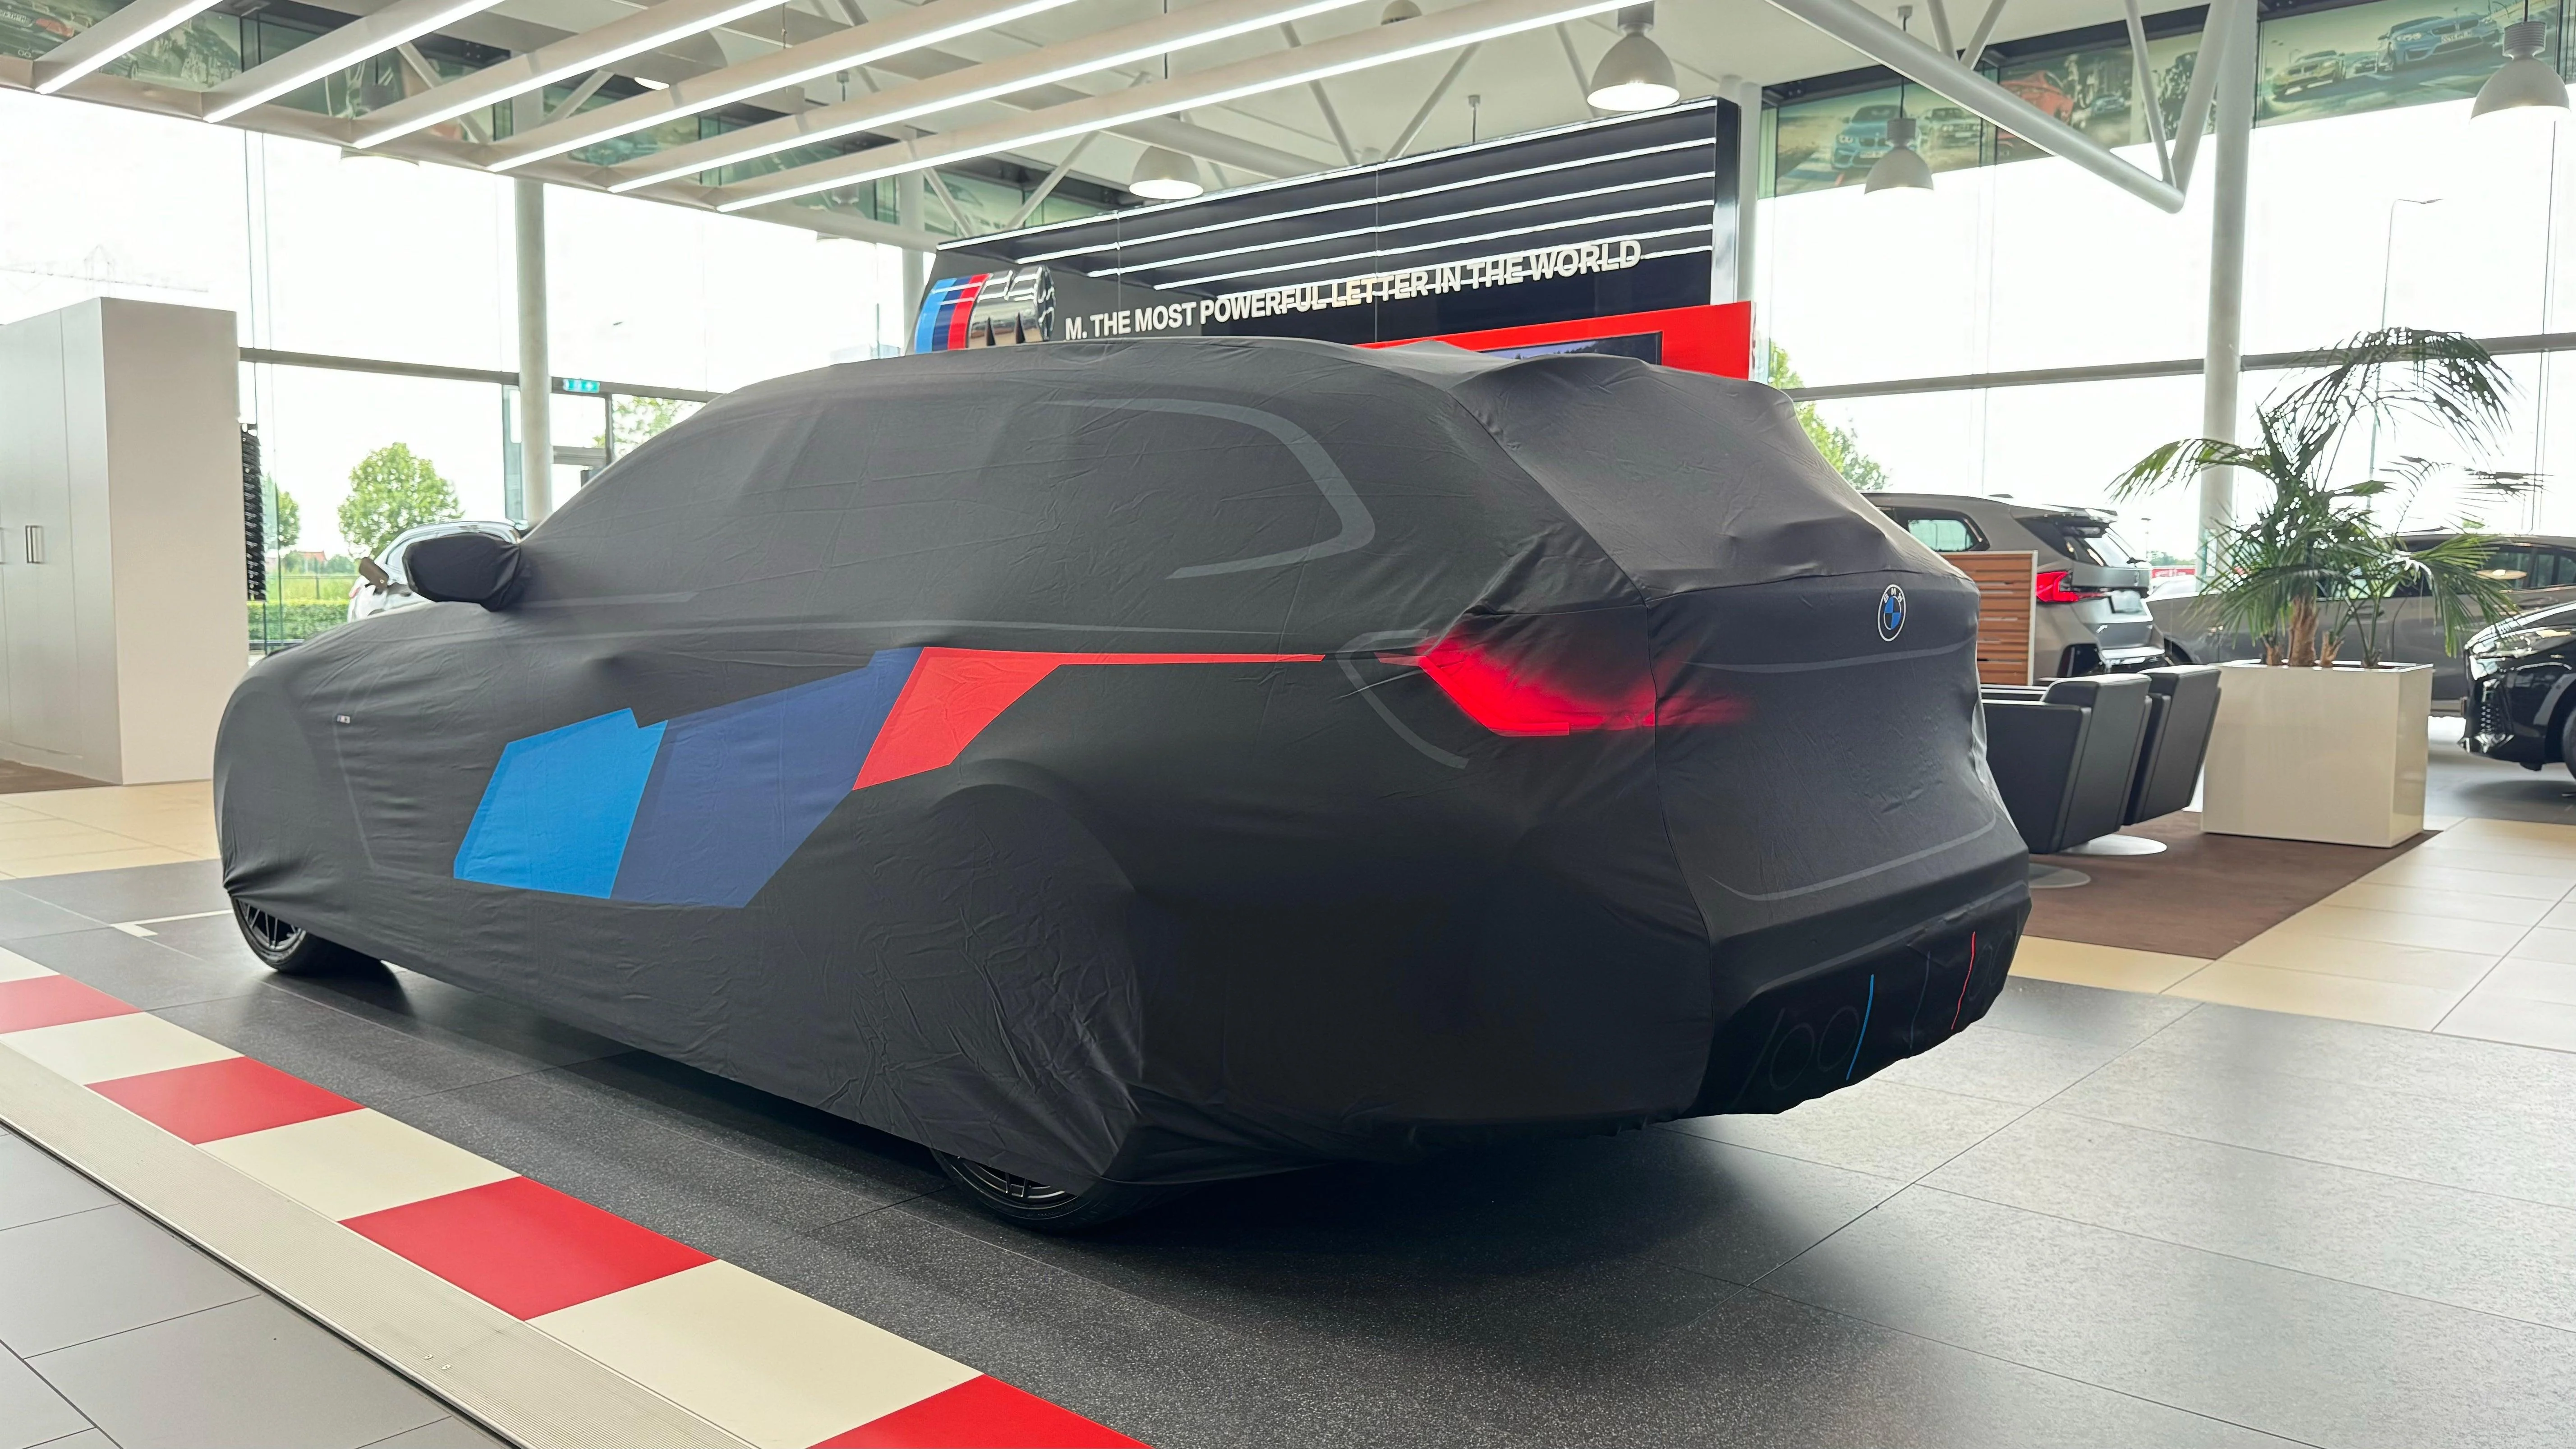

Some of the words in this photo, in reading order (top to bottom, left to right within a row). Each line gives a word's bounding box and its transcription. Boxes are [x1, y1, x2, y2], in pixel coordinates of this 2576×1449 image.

[1065, 317, 1086, 340] M.
[1090, 310, 1131, 337] THE
[1135, 302, 1196, 332] MOST
[1200, 286, 1327, 324] POWERFUL
[1331, 271, 1428, 308] LETTER
[1435, 265, 1461, 294] IN
[1467, 257, 1524, 290] THE
[1529, 240, 1641, 281] WORLD
[1883, 588, 1903, 603] BMW
